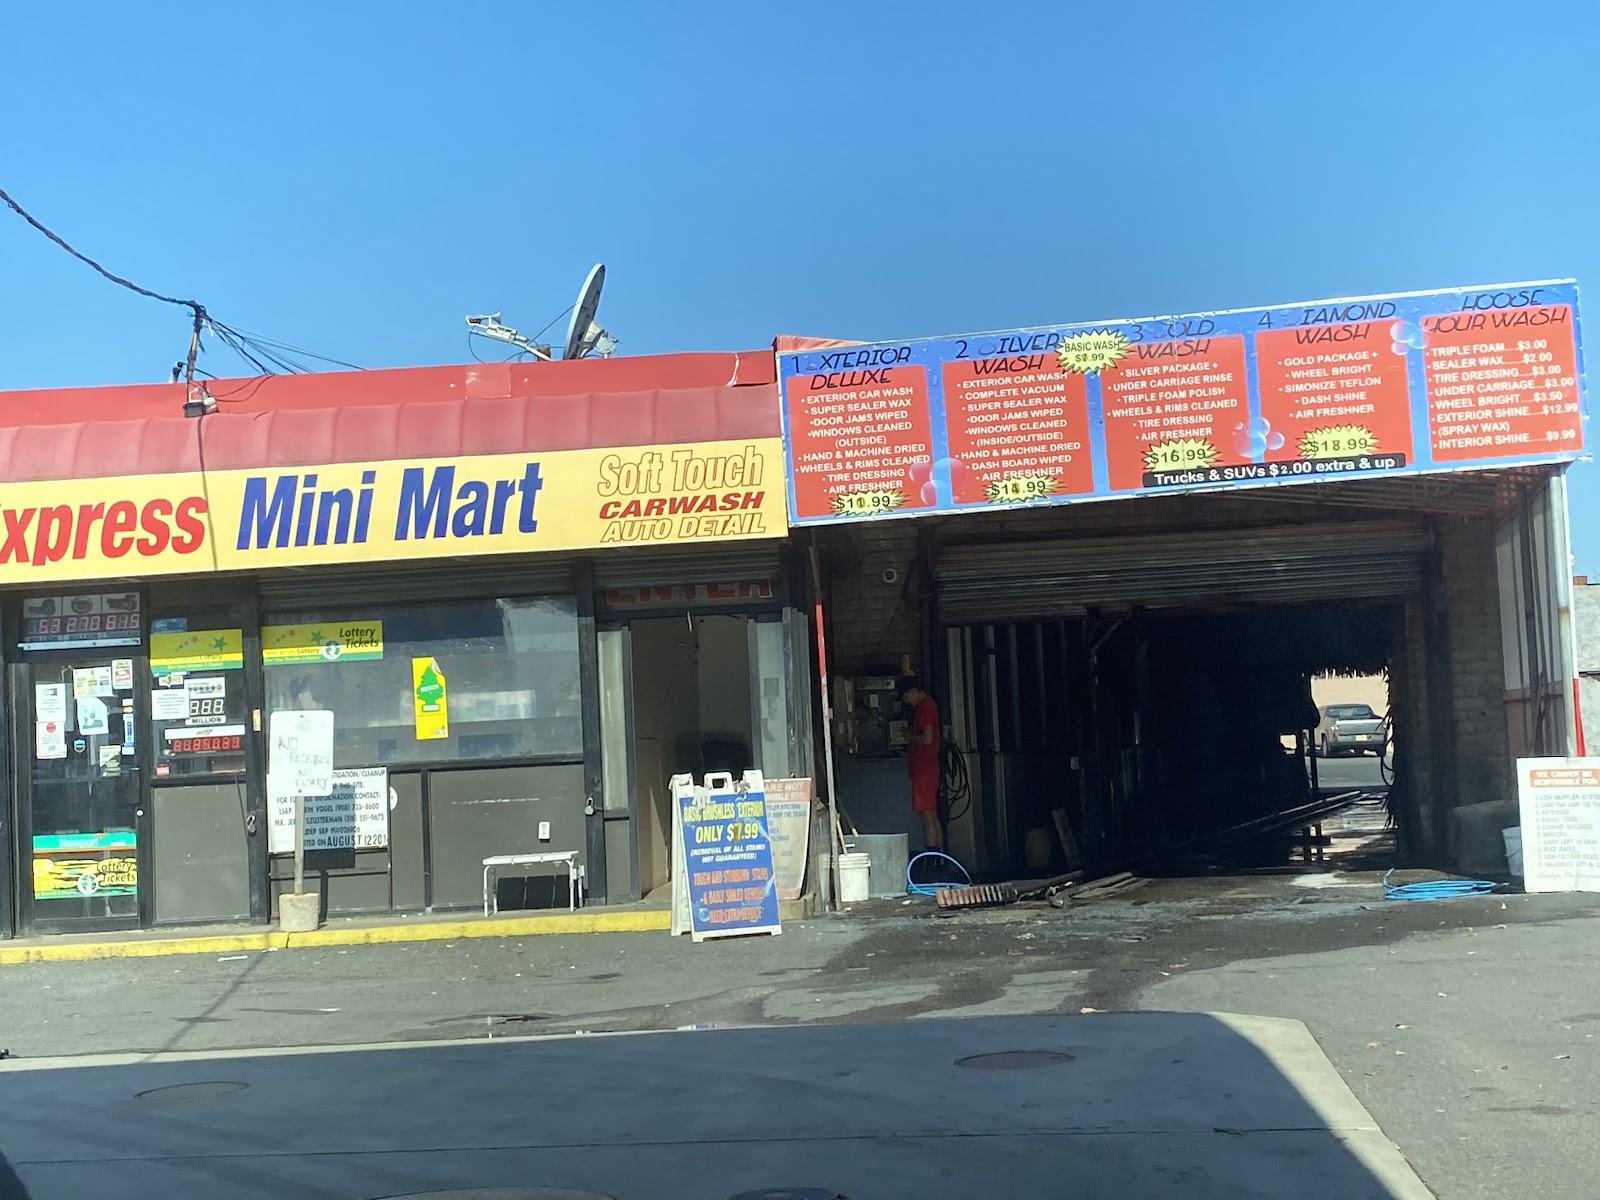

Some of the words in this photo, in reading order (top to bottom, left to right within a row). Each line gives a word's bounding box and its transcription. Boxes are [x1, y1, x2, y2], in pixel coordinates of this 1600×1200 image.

[1451, 289, 1545, 312] HOOSE
[1258, 312, 1273, 329] 4
[1285, 302, 1396, 325] IAMOND
[1492, 307, 1567, 328] WASH
[1131, 325, 1144, 342] 3
[1154, 320, 1214, 338] OLD
[1296, 323, 1370, 345] WASH
[955, 340, 969, 358] 2
[1065, 341, 1091, 352] BASIC
[1093, 340, 1120, 350] WASH
[1137, 339, 1211, 360] WASH
[1431, 345, 1470, 357] TRIPLE
[1473, 342, 1505, 353] FOAM
[1517, 339, 1547, 351] $3.00
[974, 354, 1045, 375] WASH
[1284, 356, 1314, 366] GOLD
[1317, 351, 1369, 363] PACKAGE
[1432, 358, 1476, 370] SEALER
[1478, 355, 1504, 366] WAX
[1523, 352, 1553, 364] $2.00
[1126, 368, 1160, 378] SILVER
[1162, 363, 1211, 375] PACKAGE
[1291, 369, 1329, 379] WHEEL
[1332, 364, 1372, 375] BRIGHT
[1433, 372, 1459, 384] TIRE
[1461, 368, 1520, 382] DRESSING
[810, 368, 893, 390] DELUXE
[963, 377, 1012, 389] EXTERIOR
[1014, 374, 1035, 384] CAR
[1037, 372, 1068, 382] WASH
[1113, 381, 1147, 392] UNDER
[1149, 376, 1200, 388] CARRIAGE
[1203, 373, 1233, 383] RINSE
[1285, 382, 1336, 393] SIMONIZE
[1339, 377, 1381, 388] TEFLON
[807, 391, 857, 404] EXTERIOR
[859, 390, 881, 400] CAR
[882, 387, 913, 397] WASH
[965, 388, 1019, 400] COMPLETE
[1020, 384, 1065, 395] VACUUM
[1123, 393, 1157, 403] TRIPLE
[1158, 390, 1186, 400] FOAM
[1188, 387, 1225, 398] POLISH
[1435, 384, 1475, 397] UNDER
[1477, 380, 1535, 394] CARRIAGE
[967, 402, 1001, 412] SUPER
[1003, 398, 1042, 409] SEALER
[1043, 396, 1067, 404] WAX
[1301, 395, 1331, 405] DASH
[1334, 391, 1366, 402] SHINE
[1436, 398, 1476, 410] WHEEL
[1477, 393, 1521, 406] BRIGHT
[810, 404, 845, 415] SUPER
[848, 401, 886, 412] SEALER
[887, 399, 912, 408] WAX
[1112, 407, 1153, 418] WHEELS
[1155, 405, 1163, 414] &
[1164, 402, 1189, 413] RIMS
[1191, 399, 1238, 410] CLEANED
[1296, 409, 1314, 419] AIR
[1316, 404, 1374, 417] FRESHNER
[1436, 410, 1493, 424] EXTERIOR
[1495, 406, 1530, 418] SHINE
[813, 416, 845, 427] DOOR
[846, 413, 873, 424] JAMS
[875, 410, 908, 421] WIPED
[970, 414, 1000, 424] DOOR
[1001, 411, 1029, 421] JAMS
[1031, 408, 1064, 418] WIPED
[1138, 419, 1161, 428] TIRE
[1163, 414, 1214, 426] DRESSING
[811, 426, 862, 438] WINDOWS
[864, 422, 912, 432] CLEANED
[967, 424, 1018, 435] WINDOWS
[1020, 420, 1068, 430] CLEANED
[1141, 432, 1158, 441] AIR
[1160, 427, 1212, 440] FRESHNER
[1437, 423, 1479, 437] (SPRAY
[1480, 421, 1510, 433] WAX)
[835, 435, 887, 449] (OUTSIDE)
[976, 432, 1064, 447] (INSIDE/OUTSIDE)
[1311, 438, 1368, 453] $18.99
[1439, 436, 1492, 449] INTERIOR
[1495, 433, 1531, 444] SHINE
[803, 451, 833, 462] HAND
[835, 449, 843, 459] &
[845, 446, 892, 458] MACHINE
[894, 443, 925, 453] DRIED
[961, 449, 990, 460] HAND
[992, 448, 1000, 457] &
[1001, 444, 1048, 456] MACHINE
[1050, 442, 1081, 451] DRIED
[800, 462, 843, 473] WHEELS
[845, 461, 853, 470] &
[855, 459, 880, 469] RIMS
[882, 455, 930, 466] CLEANED
[972, 461, 1000, 470] DASH
[1002, 458, 1037, 468] BOARD
[1038, 454, 1072, 464] WIPED
[597, 452, 663, 497] Soft
[671, 445, 764, 492] Touch
[828, 472, 851, 482] TIRE
[853, 469, 905, 480] DRESSING
[982, 471, 1001, 481] AIR
[1004, 467, 1064, 479] FRESHNER
[1154, 473, 1205, 486] Trucks
[1209, 470, 1220, 481] &
[1224, 465, 1266, 479] SUVs
[1269, 460, 1312, 477] $2.00
[1316, 459, 1355, 472] extra
[1359, 458, 1371, 469] &
[1375, 457, 1395, 470] up
[828, 484, 846, 494] AIR
[848, 480, 903, 492] FRESHNER
[236, 470, 377, 550] Mini
[394, 462, 543, 541] Mart
[599, 491, 765, 519] CARWASH
[600, 517, 672, 543] AUTO
[678, 513, 766, 539] DETAIL
[339, 627, 376, 638] Lottery
[345, 638, 379, 649] Tickets
[327, 835, 362, 847] AUGUST
[695, 825, 723, 843] ONLY
